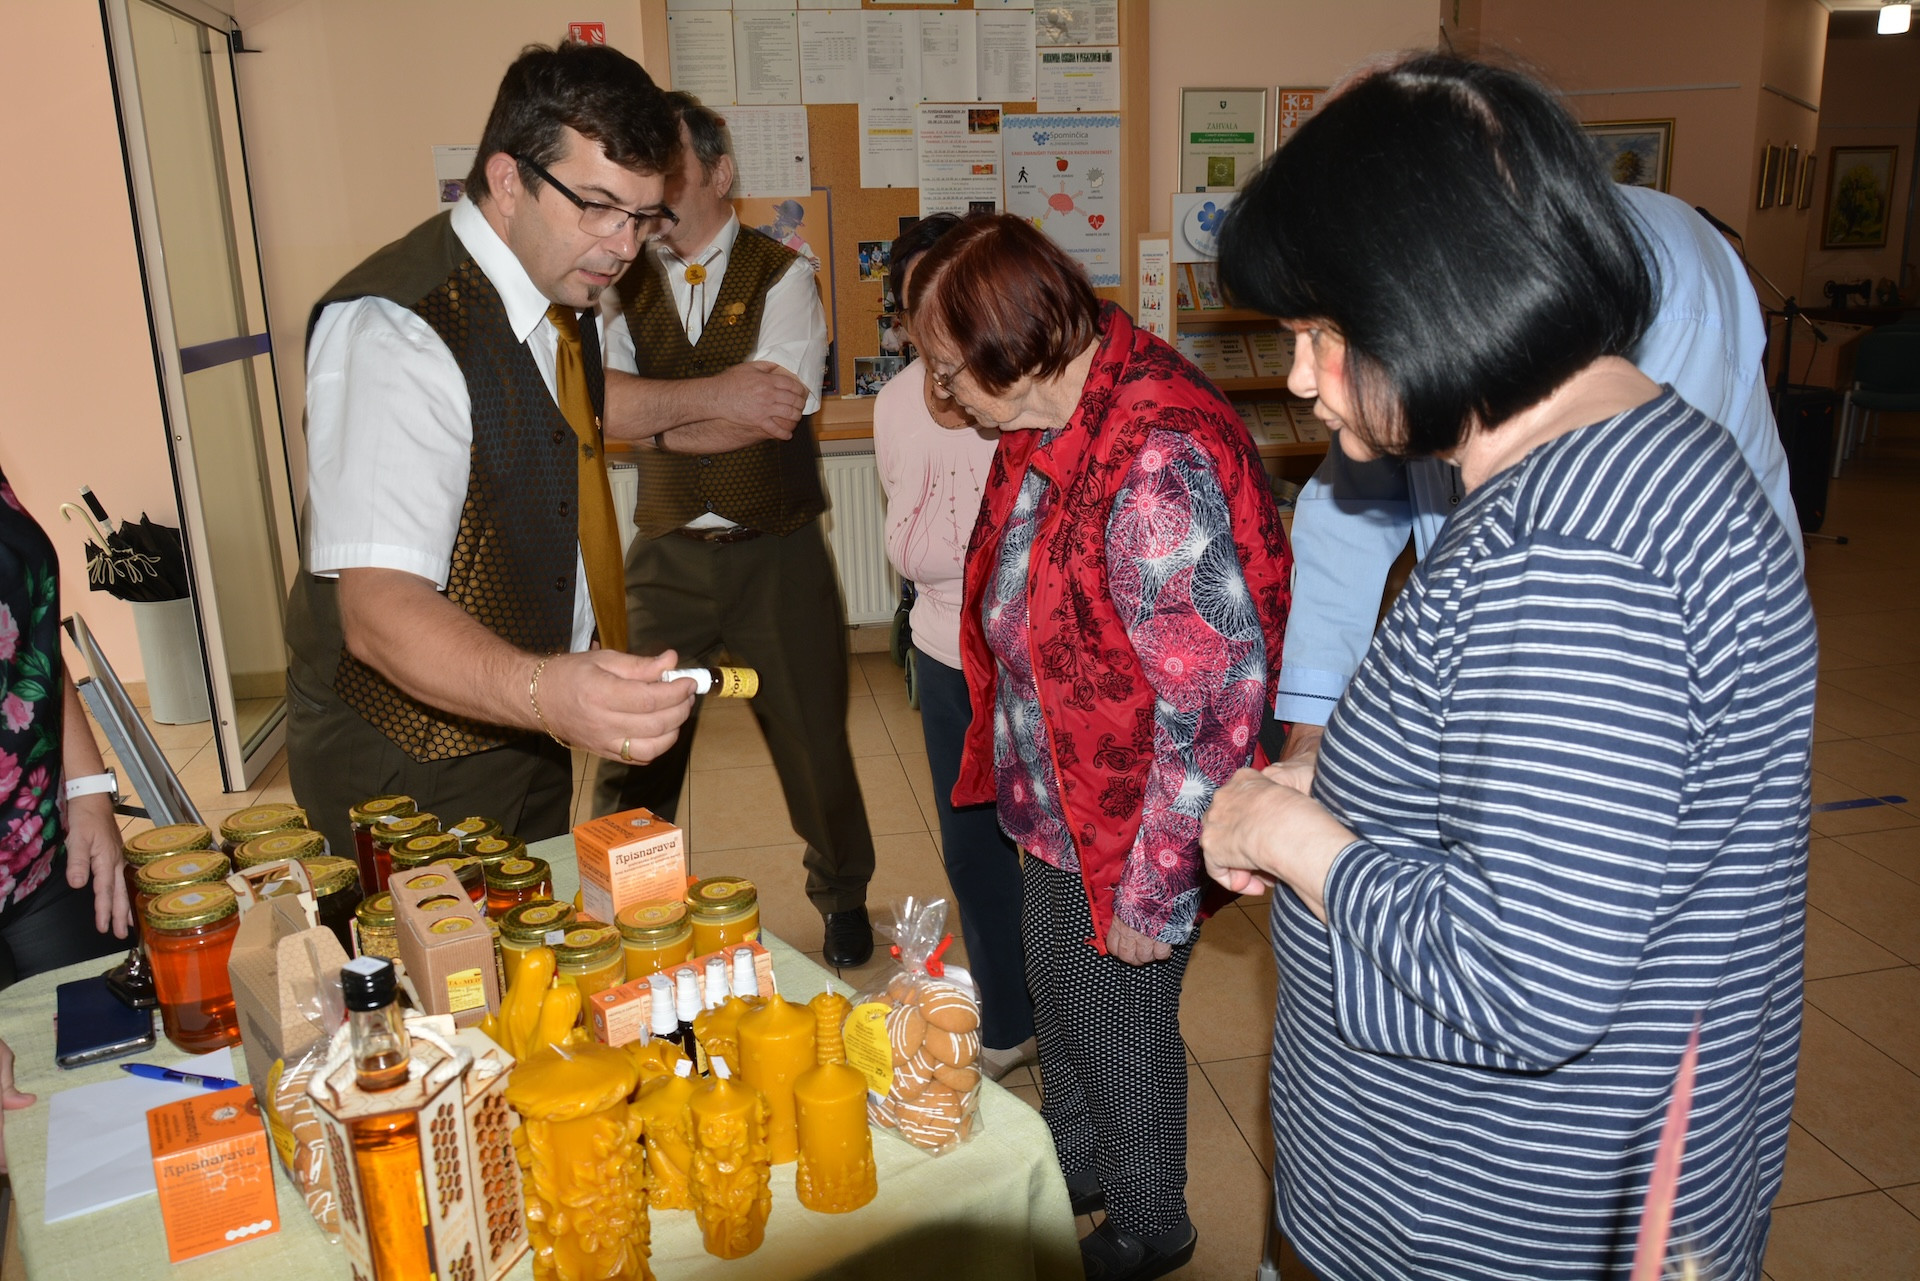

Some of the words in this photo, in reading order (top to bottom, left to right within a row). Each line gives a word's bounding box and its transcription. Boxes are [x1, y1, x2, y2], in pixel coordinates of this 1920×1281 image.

[1050, 131, 1088, 140] Spominčica
[615, 841, 677, 865] Apisnarava
[163, 1146, 256, 1179] Apisnarava
